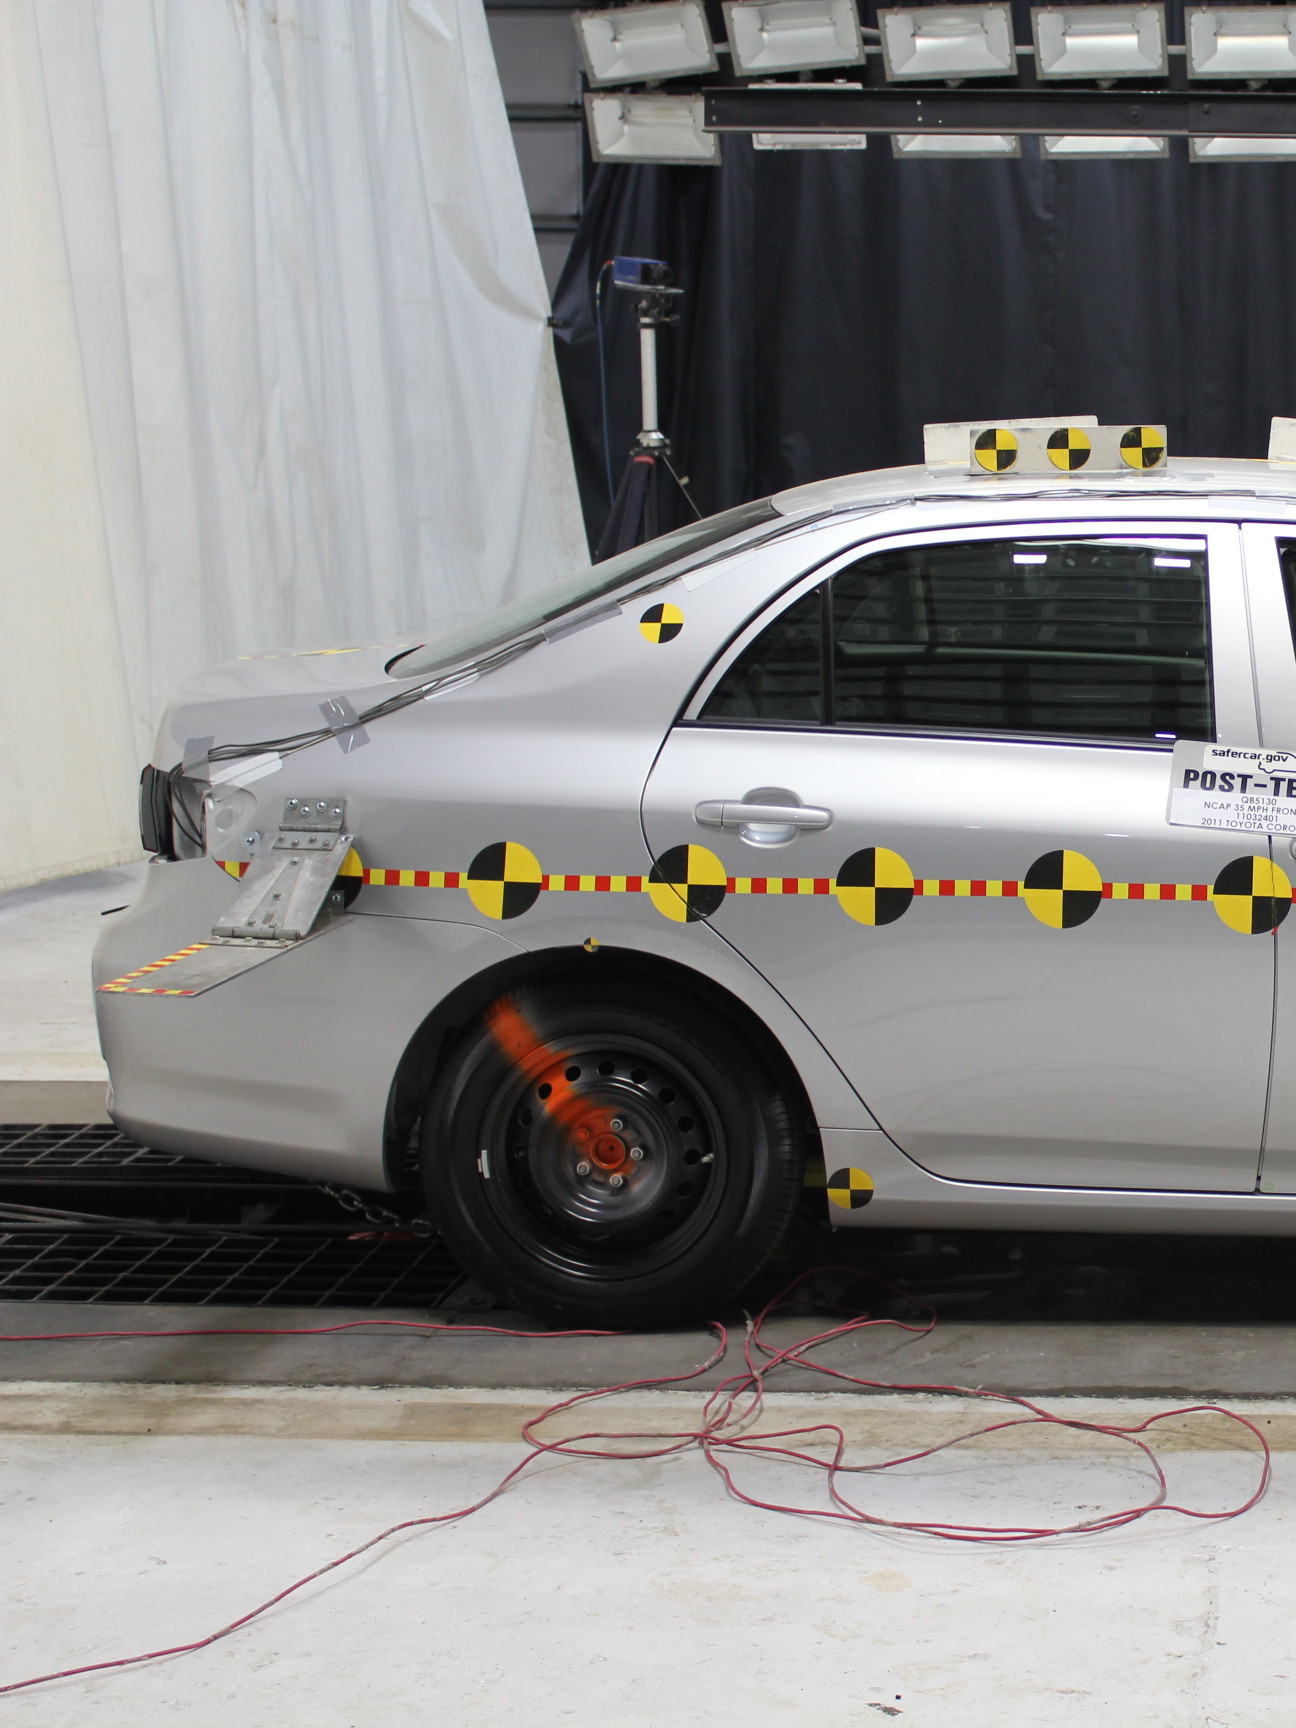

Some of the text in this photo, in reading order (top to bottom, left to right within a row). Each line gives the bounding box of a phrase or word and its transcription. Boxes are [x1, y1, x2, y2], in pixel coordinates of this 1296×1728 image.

[1212, 749, 1288, 763] safercar.gov
[1241, 796, 1277, 806] QB5130
[1203, 802, 1231, 811] NCAP
[1234, 804, 1245, 812] 35
[1247, 805, 1269, 814] MPH
[1236, 812, 1278, 822] 11032401
[1201, 818, 1222, 827] 2011
[1226, 820, 1264, 830] TOYOTA
